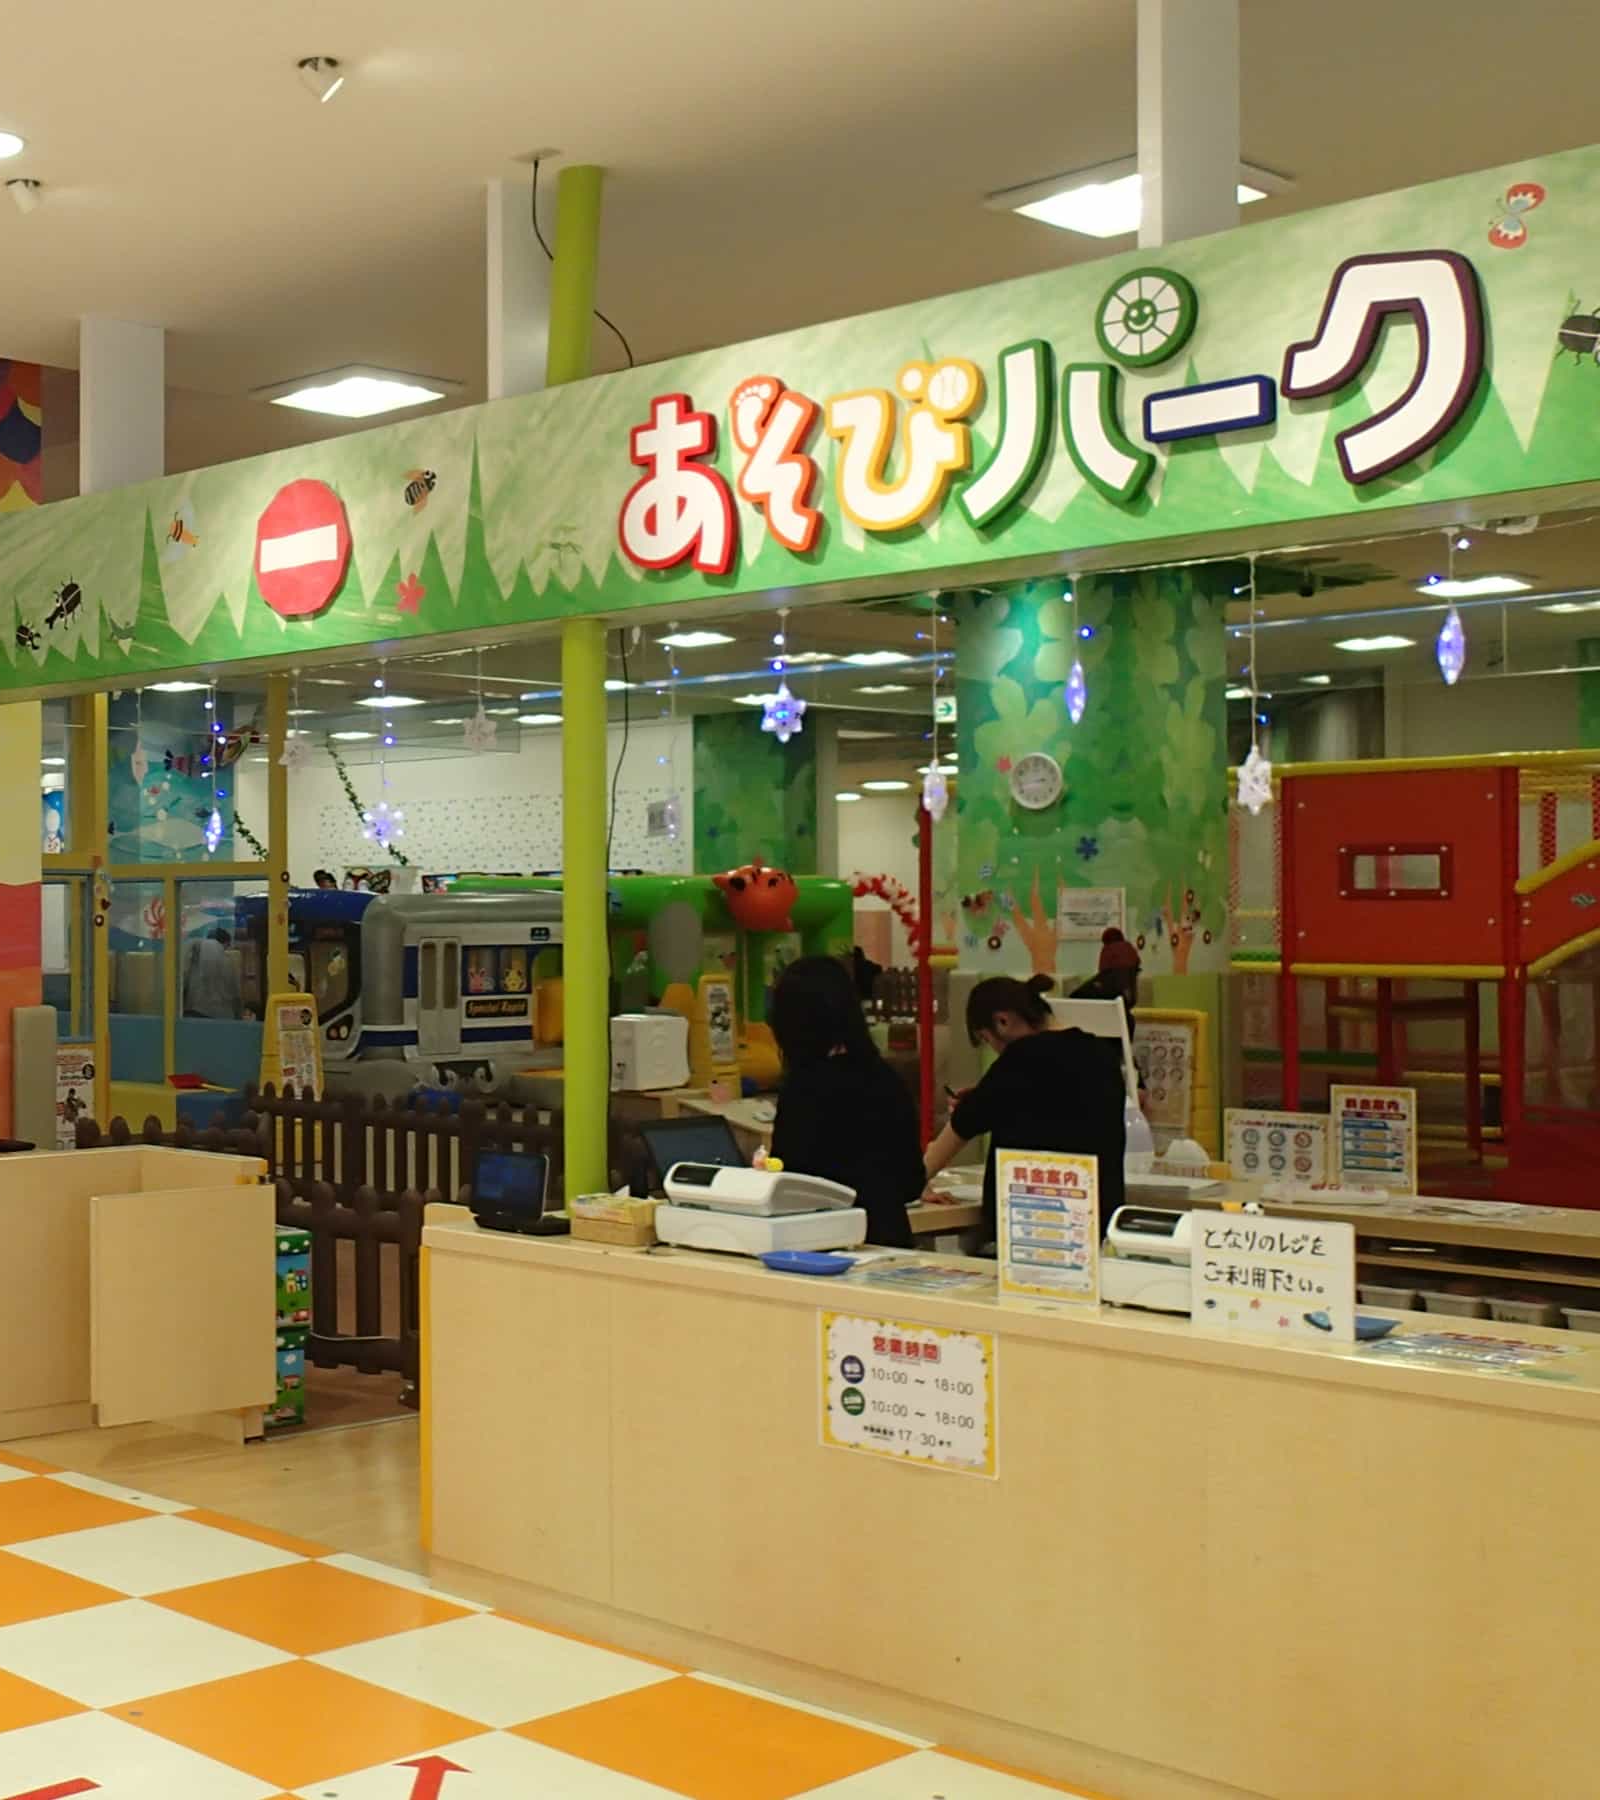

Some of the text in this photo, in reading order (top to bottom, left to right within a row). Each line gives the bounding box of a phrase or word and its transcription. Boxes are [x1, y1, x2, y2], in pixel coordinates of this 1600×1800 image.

[619, 250, 1484, 575] あそびパーク
[1204, 1227, 1328, 1257] となりのレジを
[1203, 1261, 1325, 1294] ご利用下さい。
[871, 1367, 908, 1385] 10:00
[934, 1378, 974, 1396] 18:00
[871, 1400, 908, 1418] 10:00
[935, 1411, 975, 1429] 18:00
